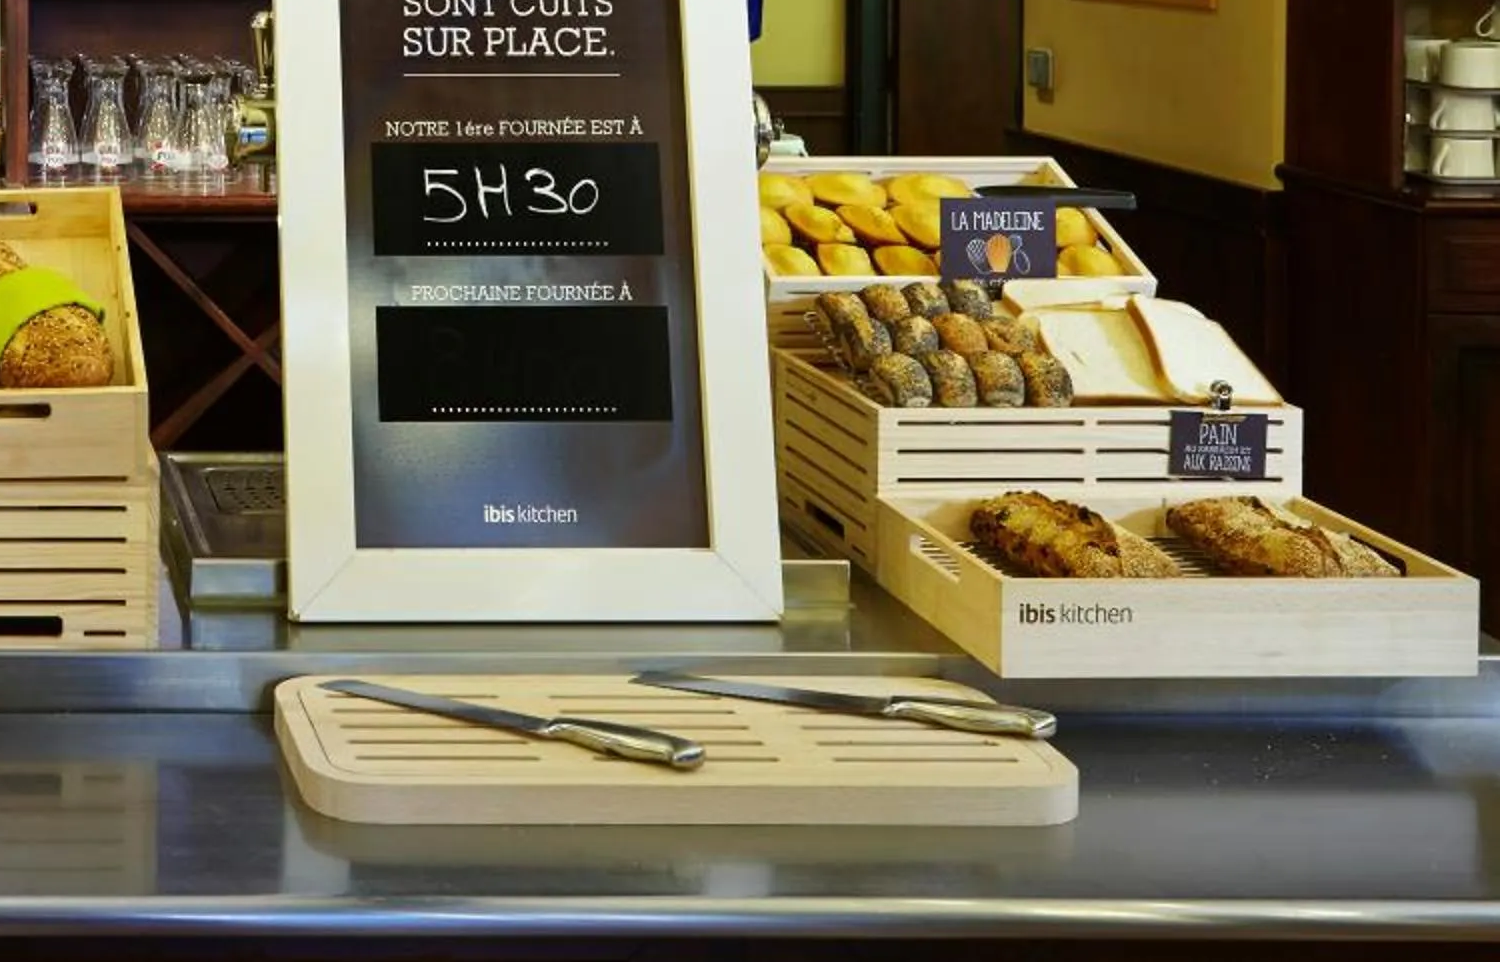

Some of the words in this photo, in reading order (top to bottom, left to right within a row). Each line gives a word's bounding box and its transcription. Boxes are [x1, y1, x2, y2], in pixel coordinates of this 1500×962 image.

[403, 26, 474, 57] SUR
[483, 26, 616, 57] PLACE.
[385, 120, 449, 137] NOTRE
[499, 117, 587, 136] FOURNÉE
[590, 120, 625, 136] EST
[629, 116, 644, 136] À
[951, 211, 969, 231] LA
[973, 211, 1045, 231] MADELEINE
[411, 285, 521, 302] PROCHAINE
[526, 283, 614, 301] FOURNÉE
[1199, 423, 1238, 445] PAIN
[1183, 454, 1206, 471] AUX
[1209, 454, 1253, 473] RAISINS
[482, 504, 516, 523] ibis
[517, 504, 578, 523] kitchen
[1019, 603, 1056, 624] ibis
[1059, 603, 1133, 624] kitchen
